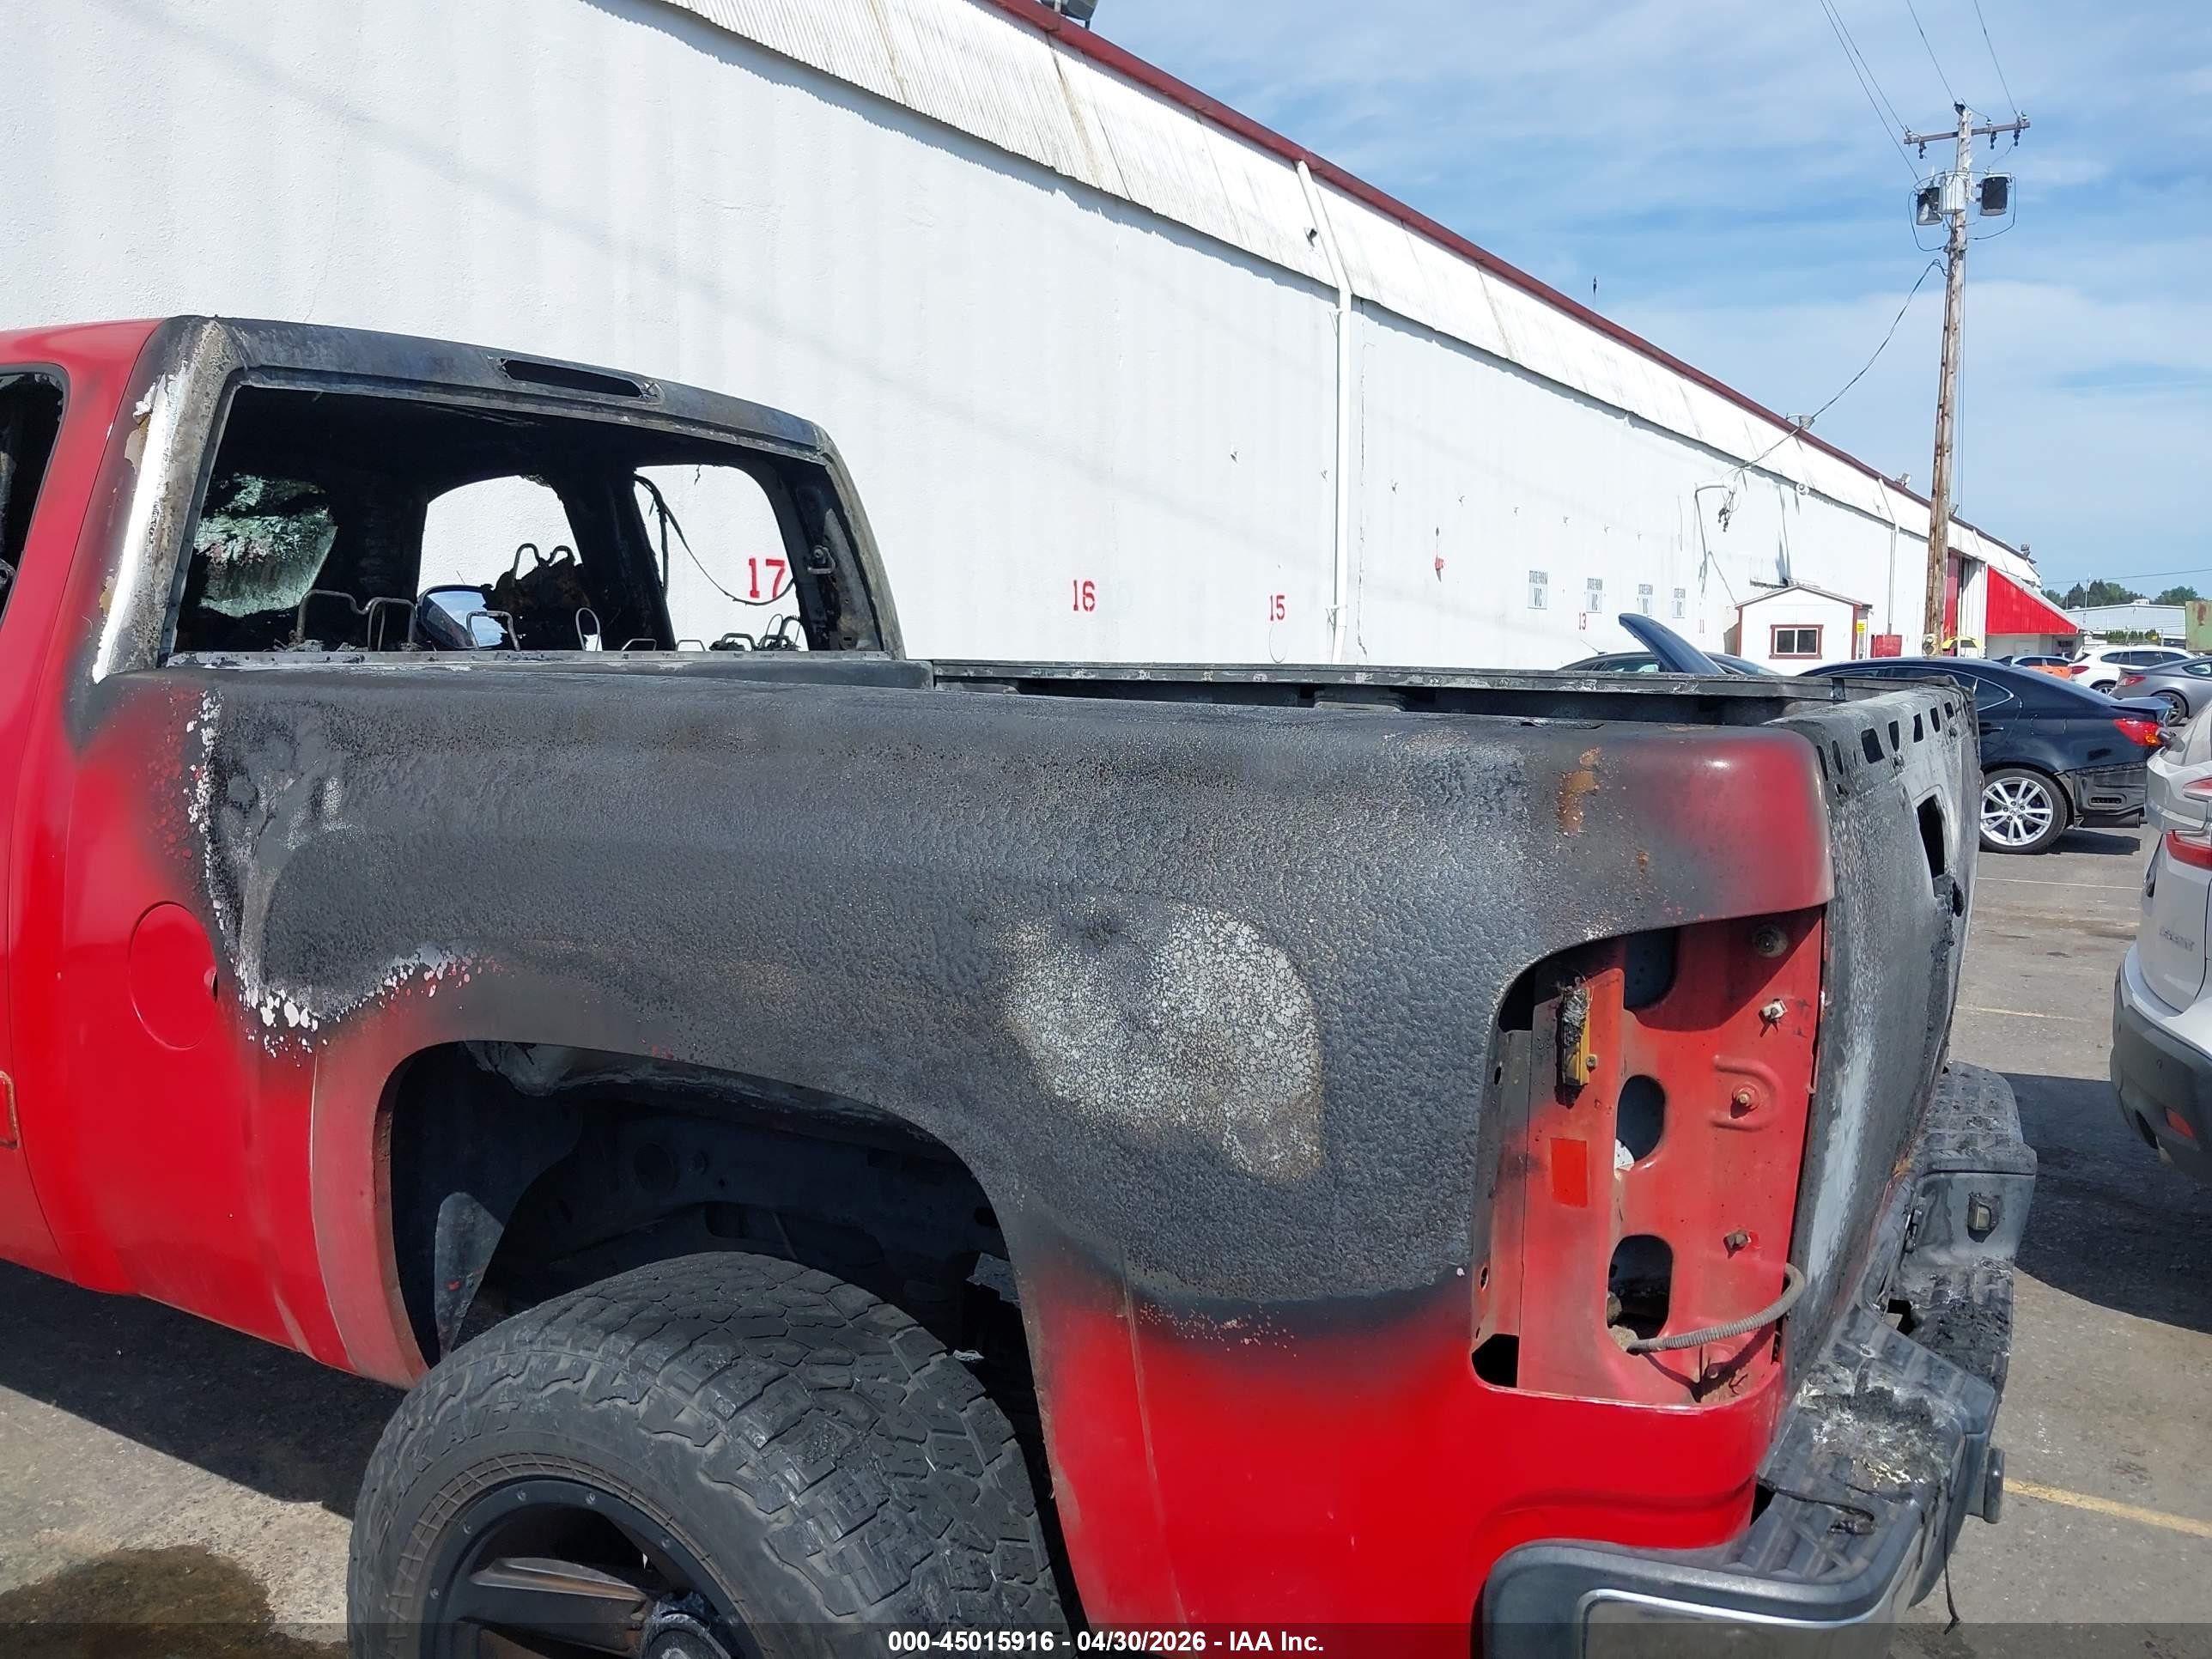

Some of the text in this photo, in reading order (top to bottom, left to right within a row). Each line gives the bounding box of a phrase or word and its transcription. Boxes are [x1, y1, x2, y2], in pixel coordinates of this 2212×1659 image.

[749, 558, 785, 599] 17
[1073, 580, 1096, 611] 16
[1270, 595, 1285, 621] 15
[1534, 587, 1542, 606] VIC
[1579, 612, 1587, 630] 13
